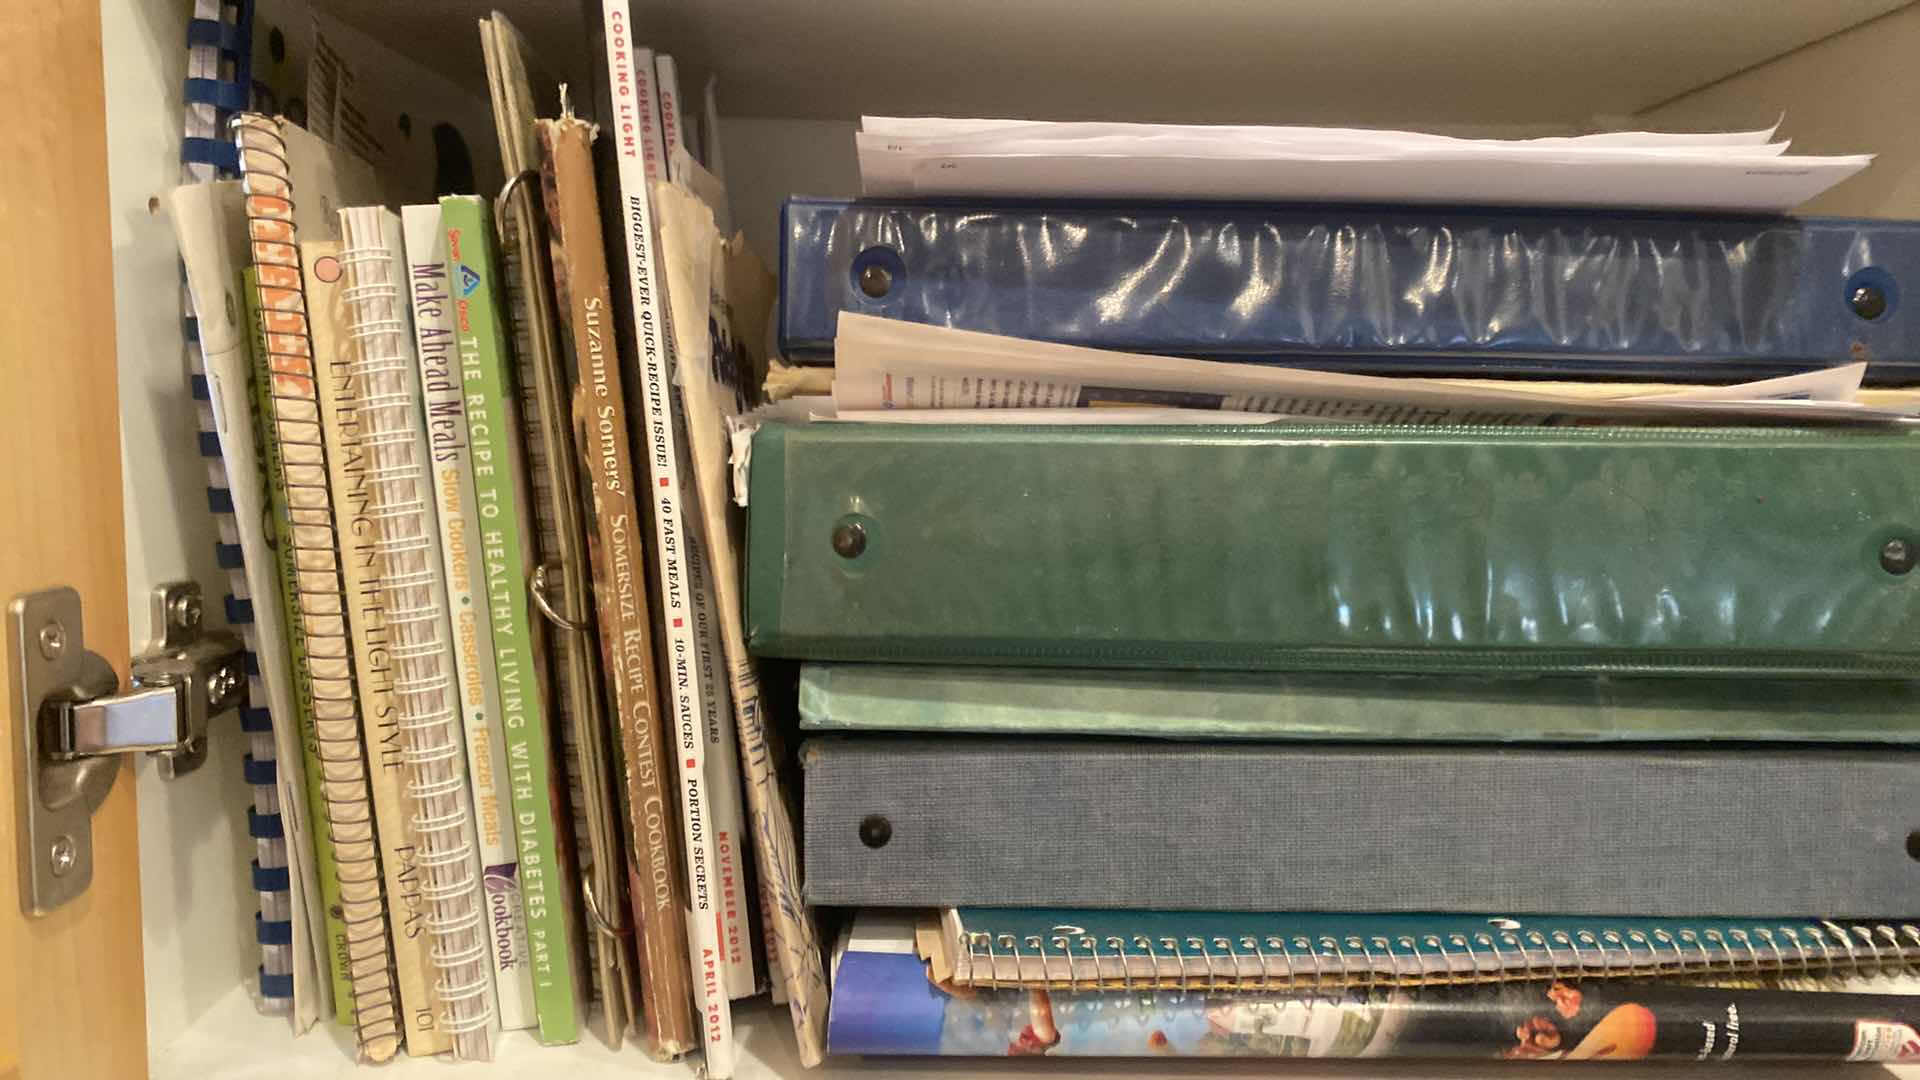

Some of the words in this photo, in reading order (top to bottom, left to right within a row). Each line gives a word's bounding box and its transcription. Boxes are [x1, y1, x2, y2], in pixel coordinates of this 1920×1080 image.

[611, 10, 629, 97] COOKING
[619, 104, 635, 158] LIGHT
[635, 69, 651, 133] COOKING
[642, 138, 656, 180] LIGHT
[629, 195, 650, 306] BIGGEST-EVER
[410, 260, 445, 320] Make
[417, 324, 457, 395] Ahead
[459, 336, 480, 381] THE
[583, 296, 612, 397] Suzanne
[639, 310, 661, 416] QUICK-RECIPE
[328, 360, 374, 536] ENTERTAINING
[427, 397, 465, 463] Meals
[466, 393, 493, 477] RECIPE
[596, 404, 625, 497] Somers'
[652, 419, 667, 468] ISSUE!
[440, 467, 463, 514] Slow
[478, 488, 498, 518] TO
[660, 497, 671, 514] 40
[354, 543, 378, 568] IN
[445, 517, 472, 593] Cookers
[609, 513, 638, 621] SOMERSIZE
[662, 518, 675, 554] FAST
[358, 576, 385, 622] THE
[483, 531, 515, 637] HEALTHY
[666, 558, 680, 608] MEALS
[694, 592, 705, 609] OF
[457, 610, 487, 705] Casseroles
[697, 613, 708, 638] OUR
[364, 626, 394, 697] LIGHT
[498, 647, 525, 730] LIVING
[623, 628, 647, 693] RECIPE
[674, 637, 688, 690] 10-MIN.
[700, 642, 712, 680] FIRST
[374, 702, 404, 775] STYLE
[631, 700, 658, 789] CONTEST
[679, 694, 693, 749] SAUCES
[706, 700, 720, 744] YEARS
[471, 727, 495, 790] Freezer
[510, 740, 533, 801] WITH
[480, 794, 501, 849] Meals
[686, 778, 702, 842] PORTION
[517, 811, 547, 920] DIABETES
[642, 795, 671, 911] COOKBOOK
[693, 846, 708, 910] SECRETS
[393, 845, 426, 940] PAPPAS
[718, 831, 736, 919] NOVEMBER
[727, 925, 741, 964] 2012
[531, 927, 551, 973] PART
[702, 948, 716, 997] APRIL
[708, 1004, 720, 1042] 2012
